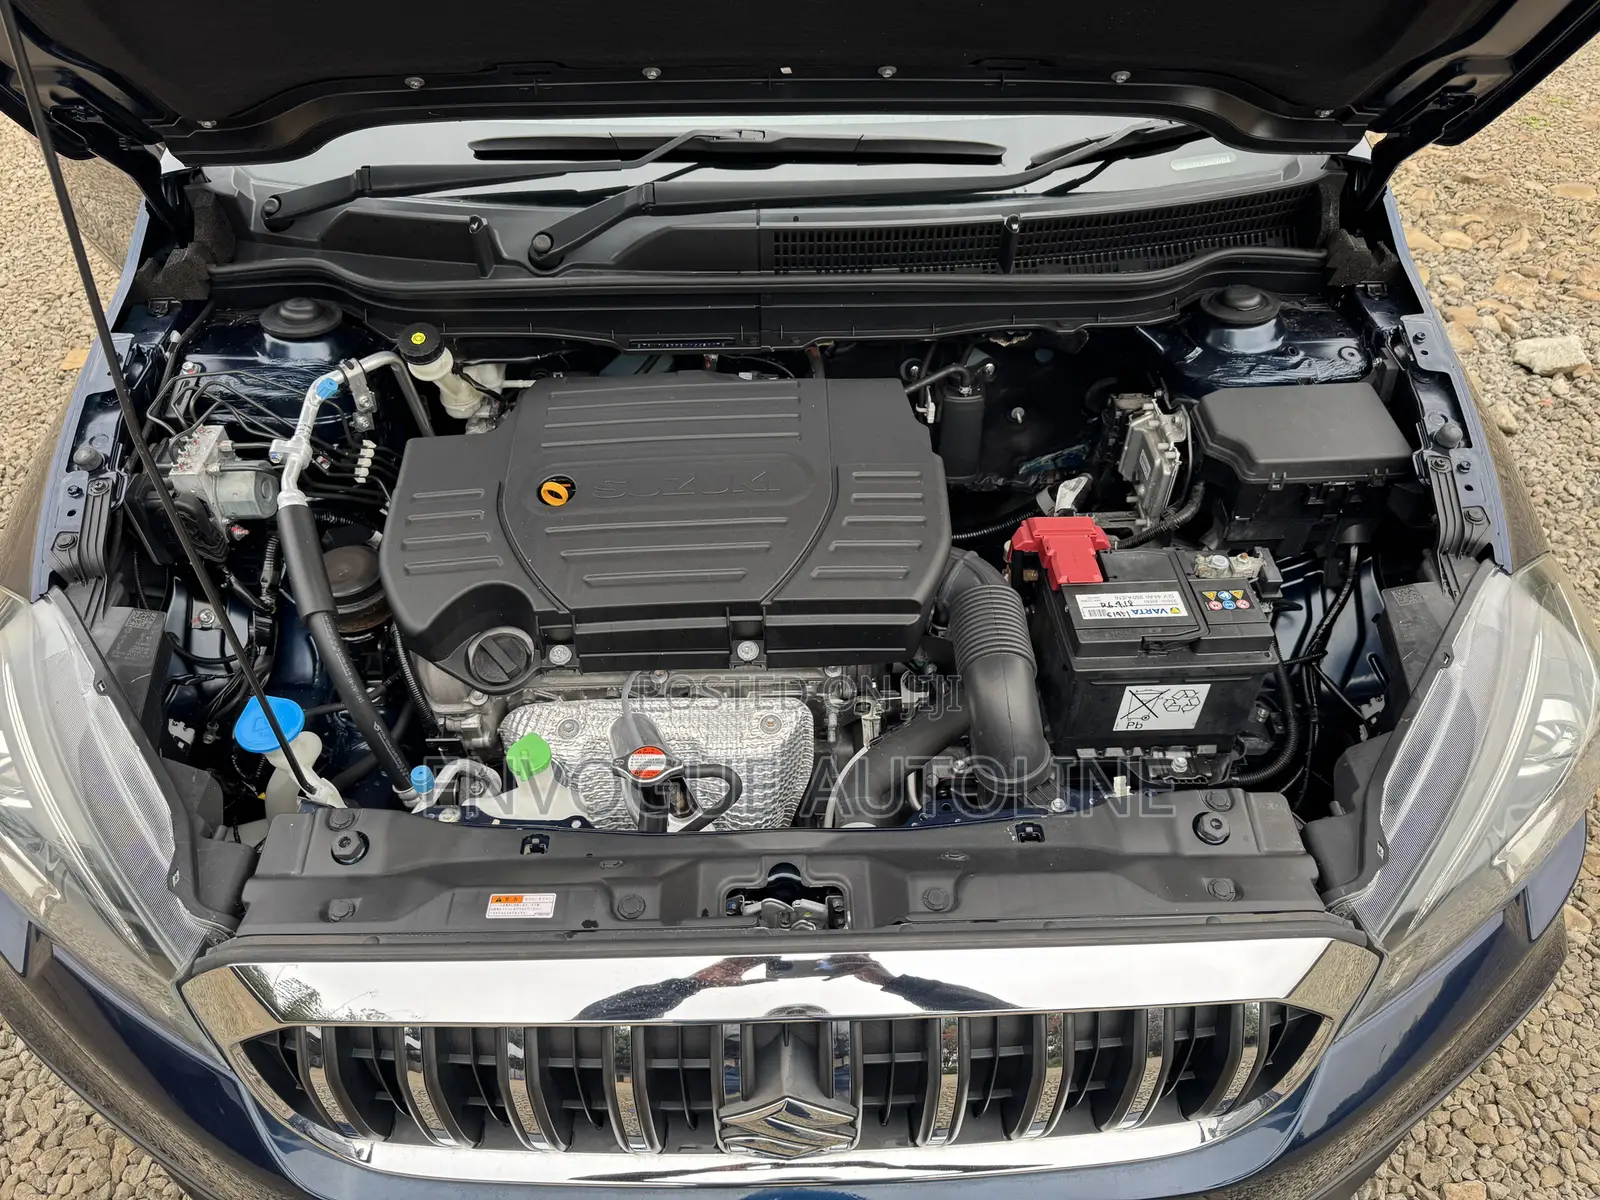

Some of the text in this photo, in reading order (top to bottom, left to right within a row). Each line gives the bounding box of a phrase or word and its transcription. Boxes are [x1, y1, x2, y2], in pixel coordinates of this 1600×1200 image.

[592, 471, 780, 498] SUZUKI
[1131, 607, 1169, 615] VARTA
[1126, 721, 1143, 730] Pb
